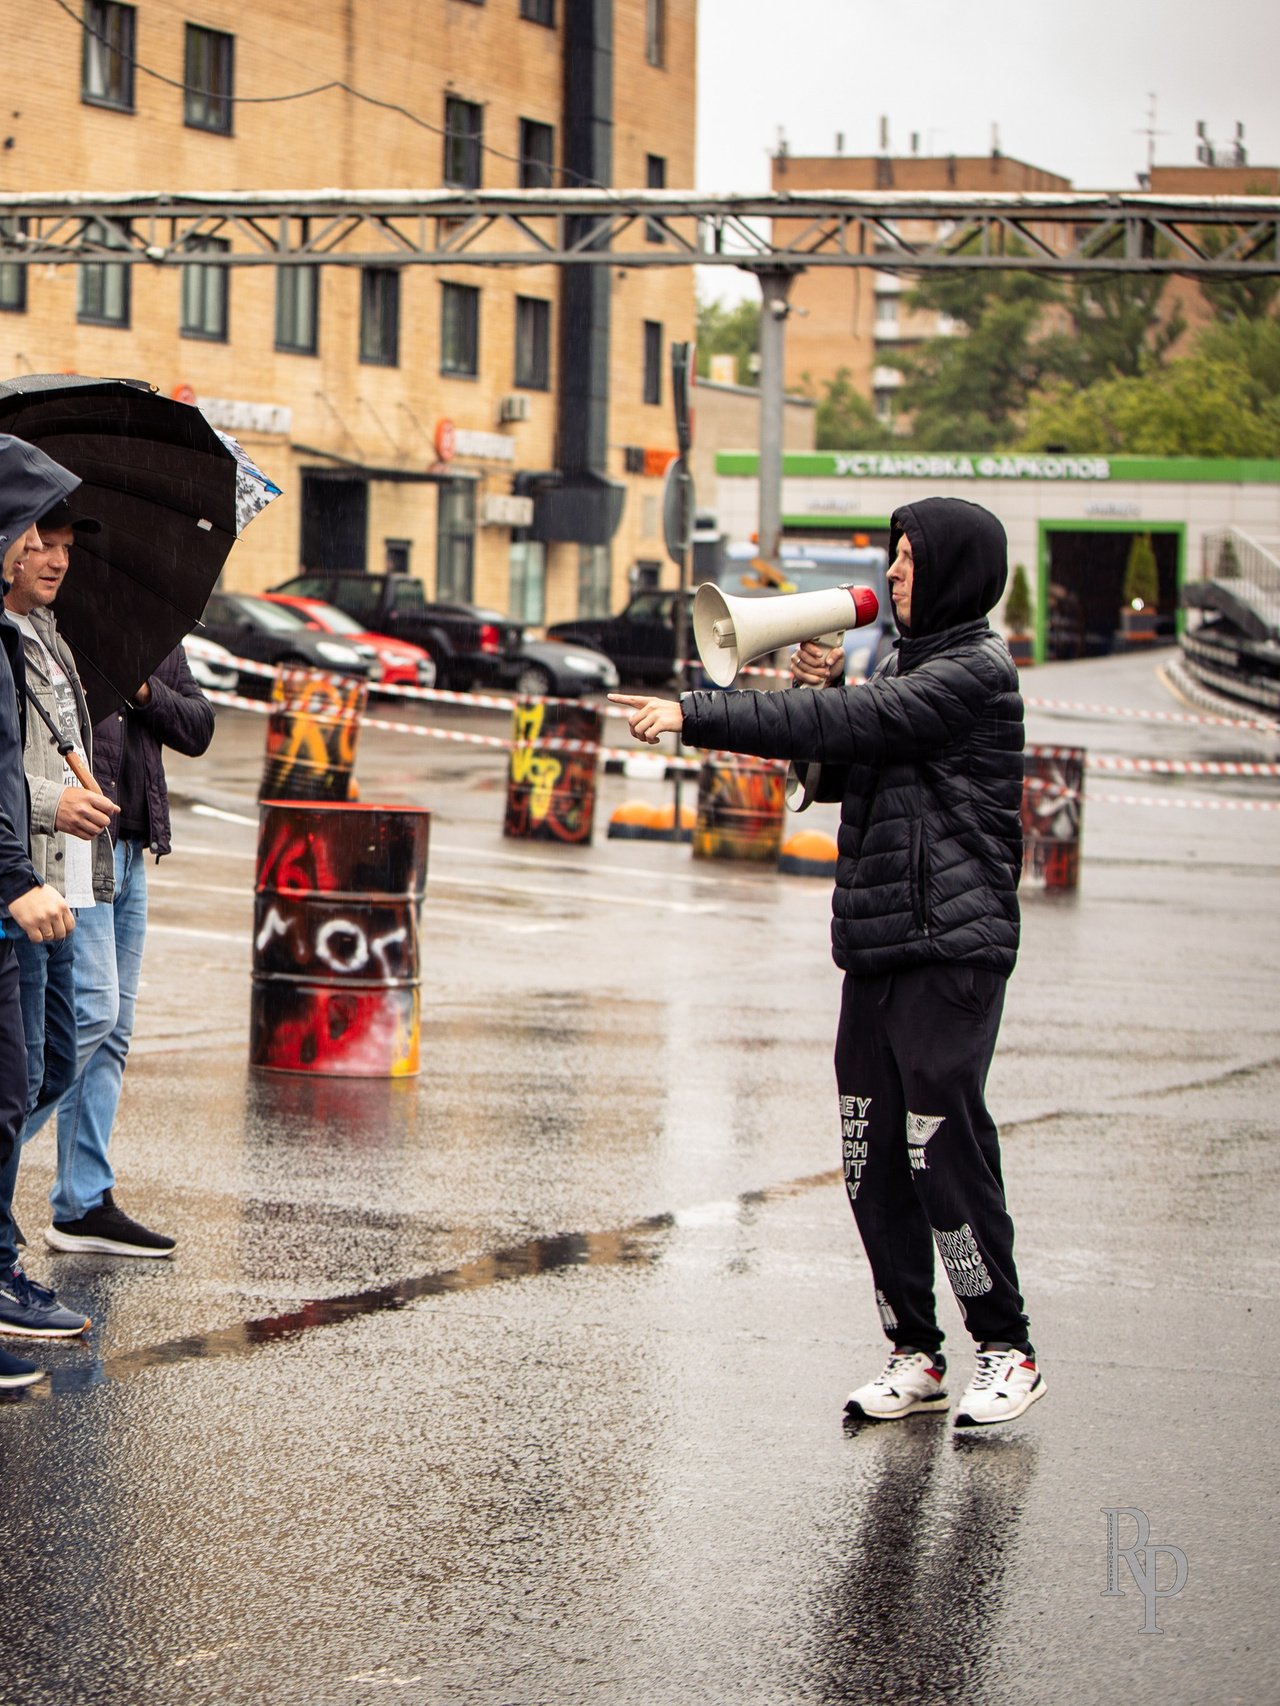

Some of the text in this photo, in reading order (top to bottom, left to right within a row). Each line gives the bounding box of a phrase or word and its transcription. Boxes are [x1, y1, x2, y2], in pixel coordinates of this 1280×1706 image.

[834, 456, 1111, 479] УСТАНОВКА ФАРКОПОВ
[942, 1250, 982, 1271] DING
